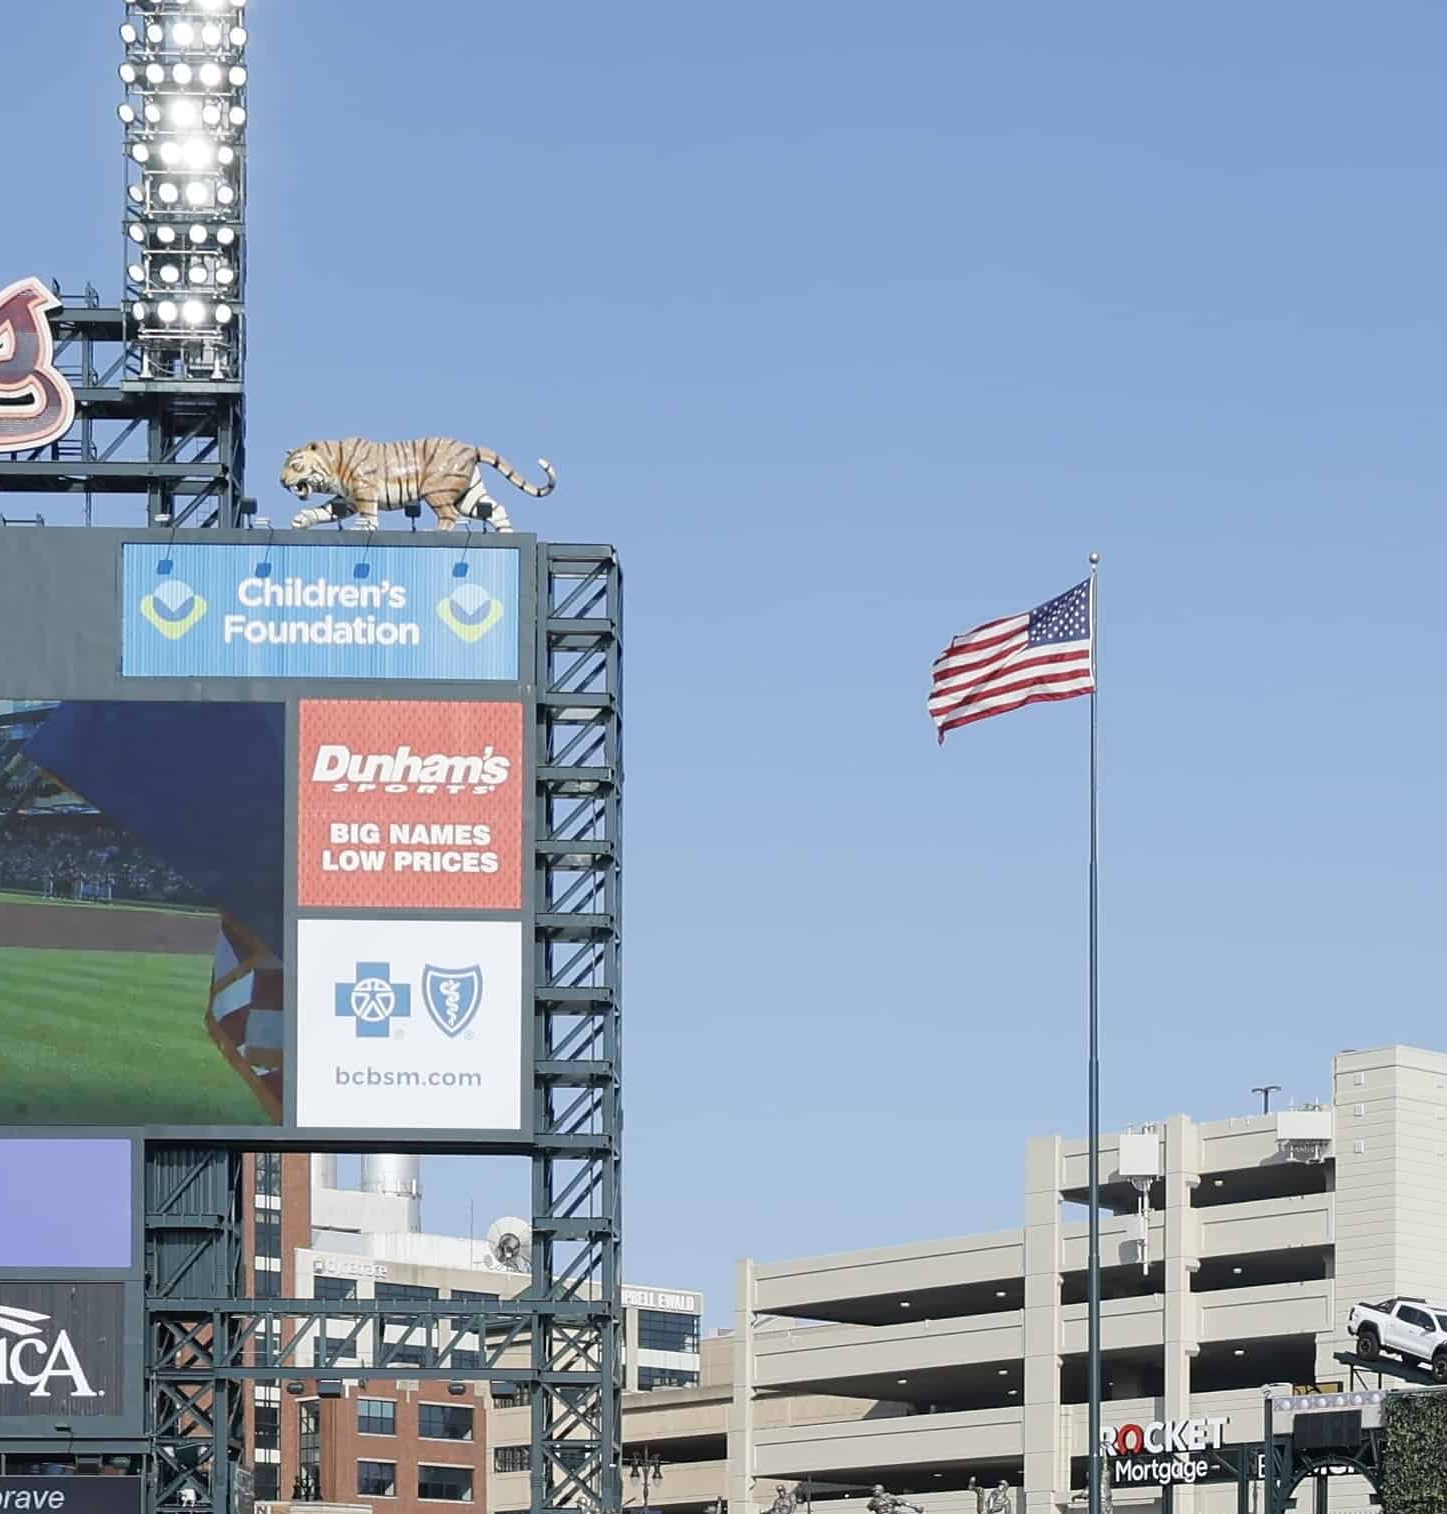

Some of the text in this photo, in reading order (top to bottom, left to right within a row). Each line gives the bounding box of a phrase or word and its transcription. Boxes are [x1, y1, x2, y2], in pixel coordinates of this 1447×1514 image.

[238, 577, 407, 609] Children's
[223, 614, 420, 645] Foundation
[312, 745, 510, 784] Dunham's
[332, 783, 491, 795] SPORTS
[330, 823, 491, 845] BIG NAMES
[322, 850, 499, 872] LOW PRICES
[335, 1065, 482, 1086] bcbsm.com
[1100, 1417, 1225, 1456] ROCKET
[1115, 1458, 1208, 1484] Mortgage
